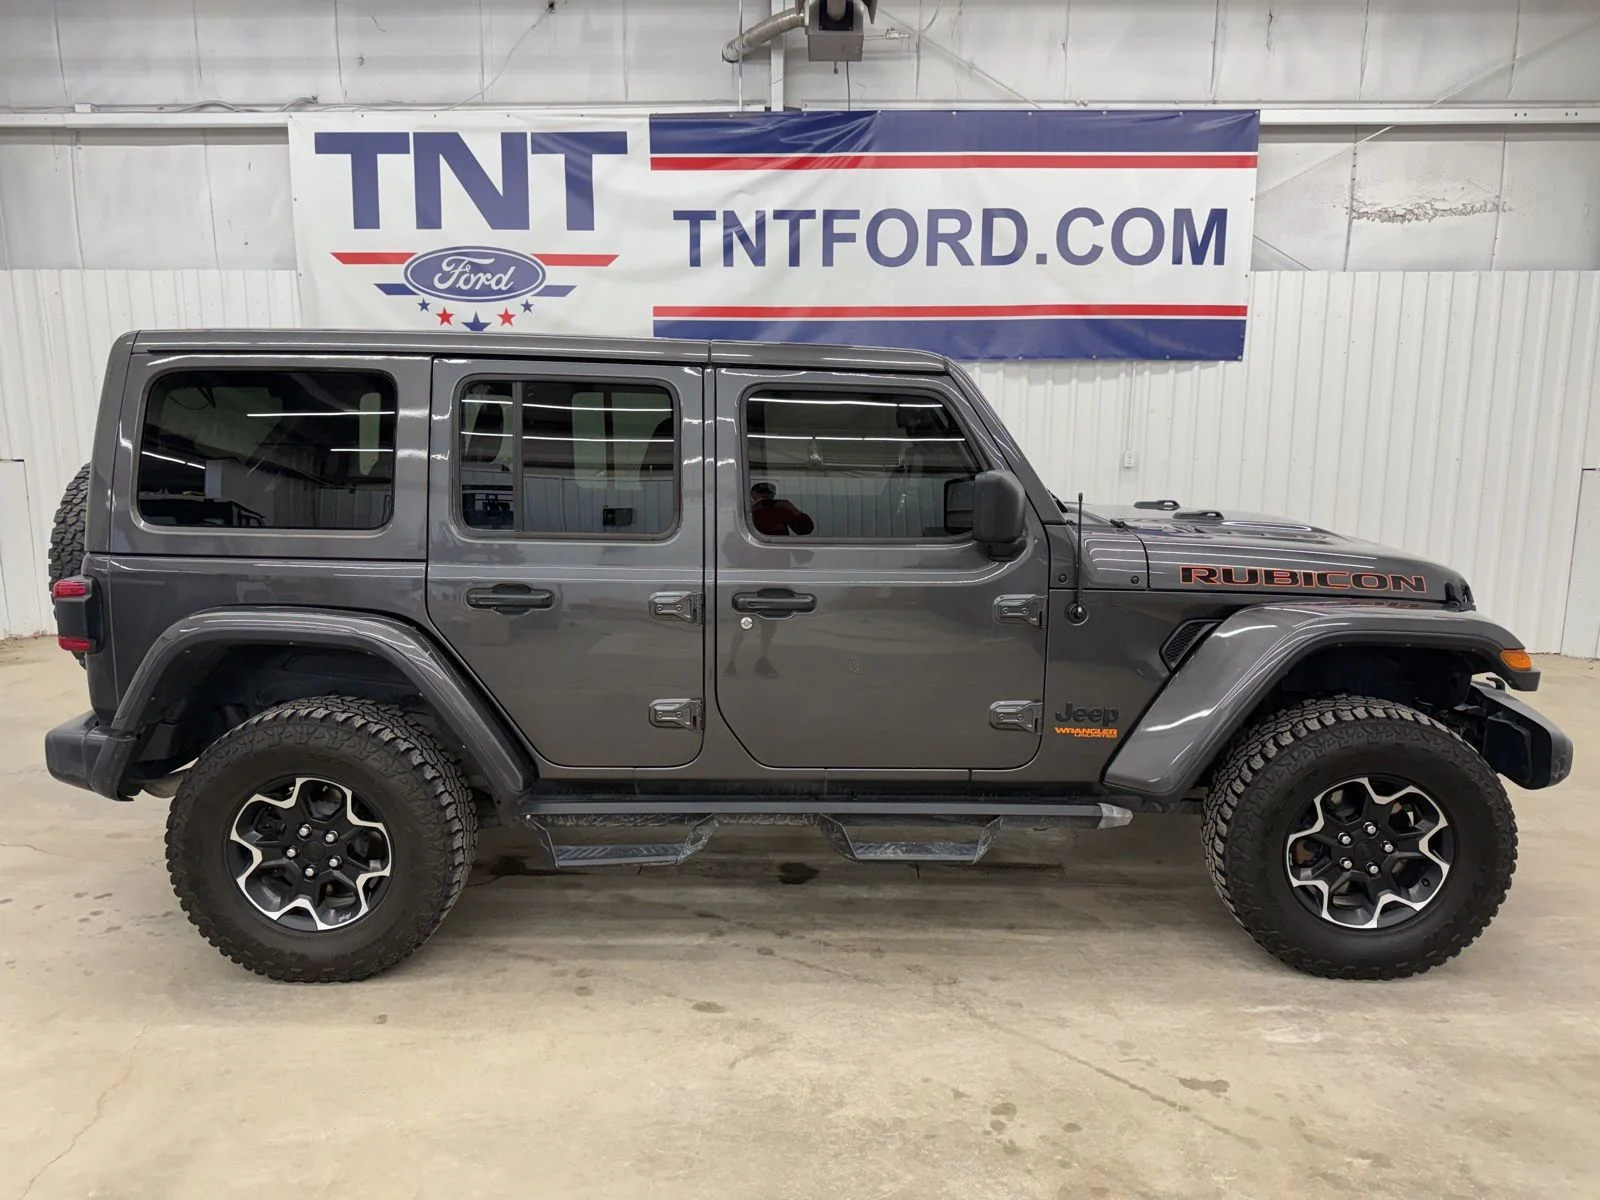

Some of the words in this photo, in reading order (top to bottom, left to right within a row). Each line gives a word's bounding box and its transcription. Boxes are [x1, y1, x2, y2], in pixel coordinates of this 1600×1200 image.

[314, 131, 628, 231] TNT
[673, 207, 1227, 268] TNTFORD.COM
[433, 256, 516, 291] Ford
[1179, 565, 1427, 593] RUBICON
[1055, 701, 1119, 727] Jeep
[1054, 727, 1118, 735] WRANGLER
